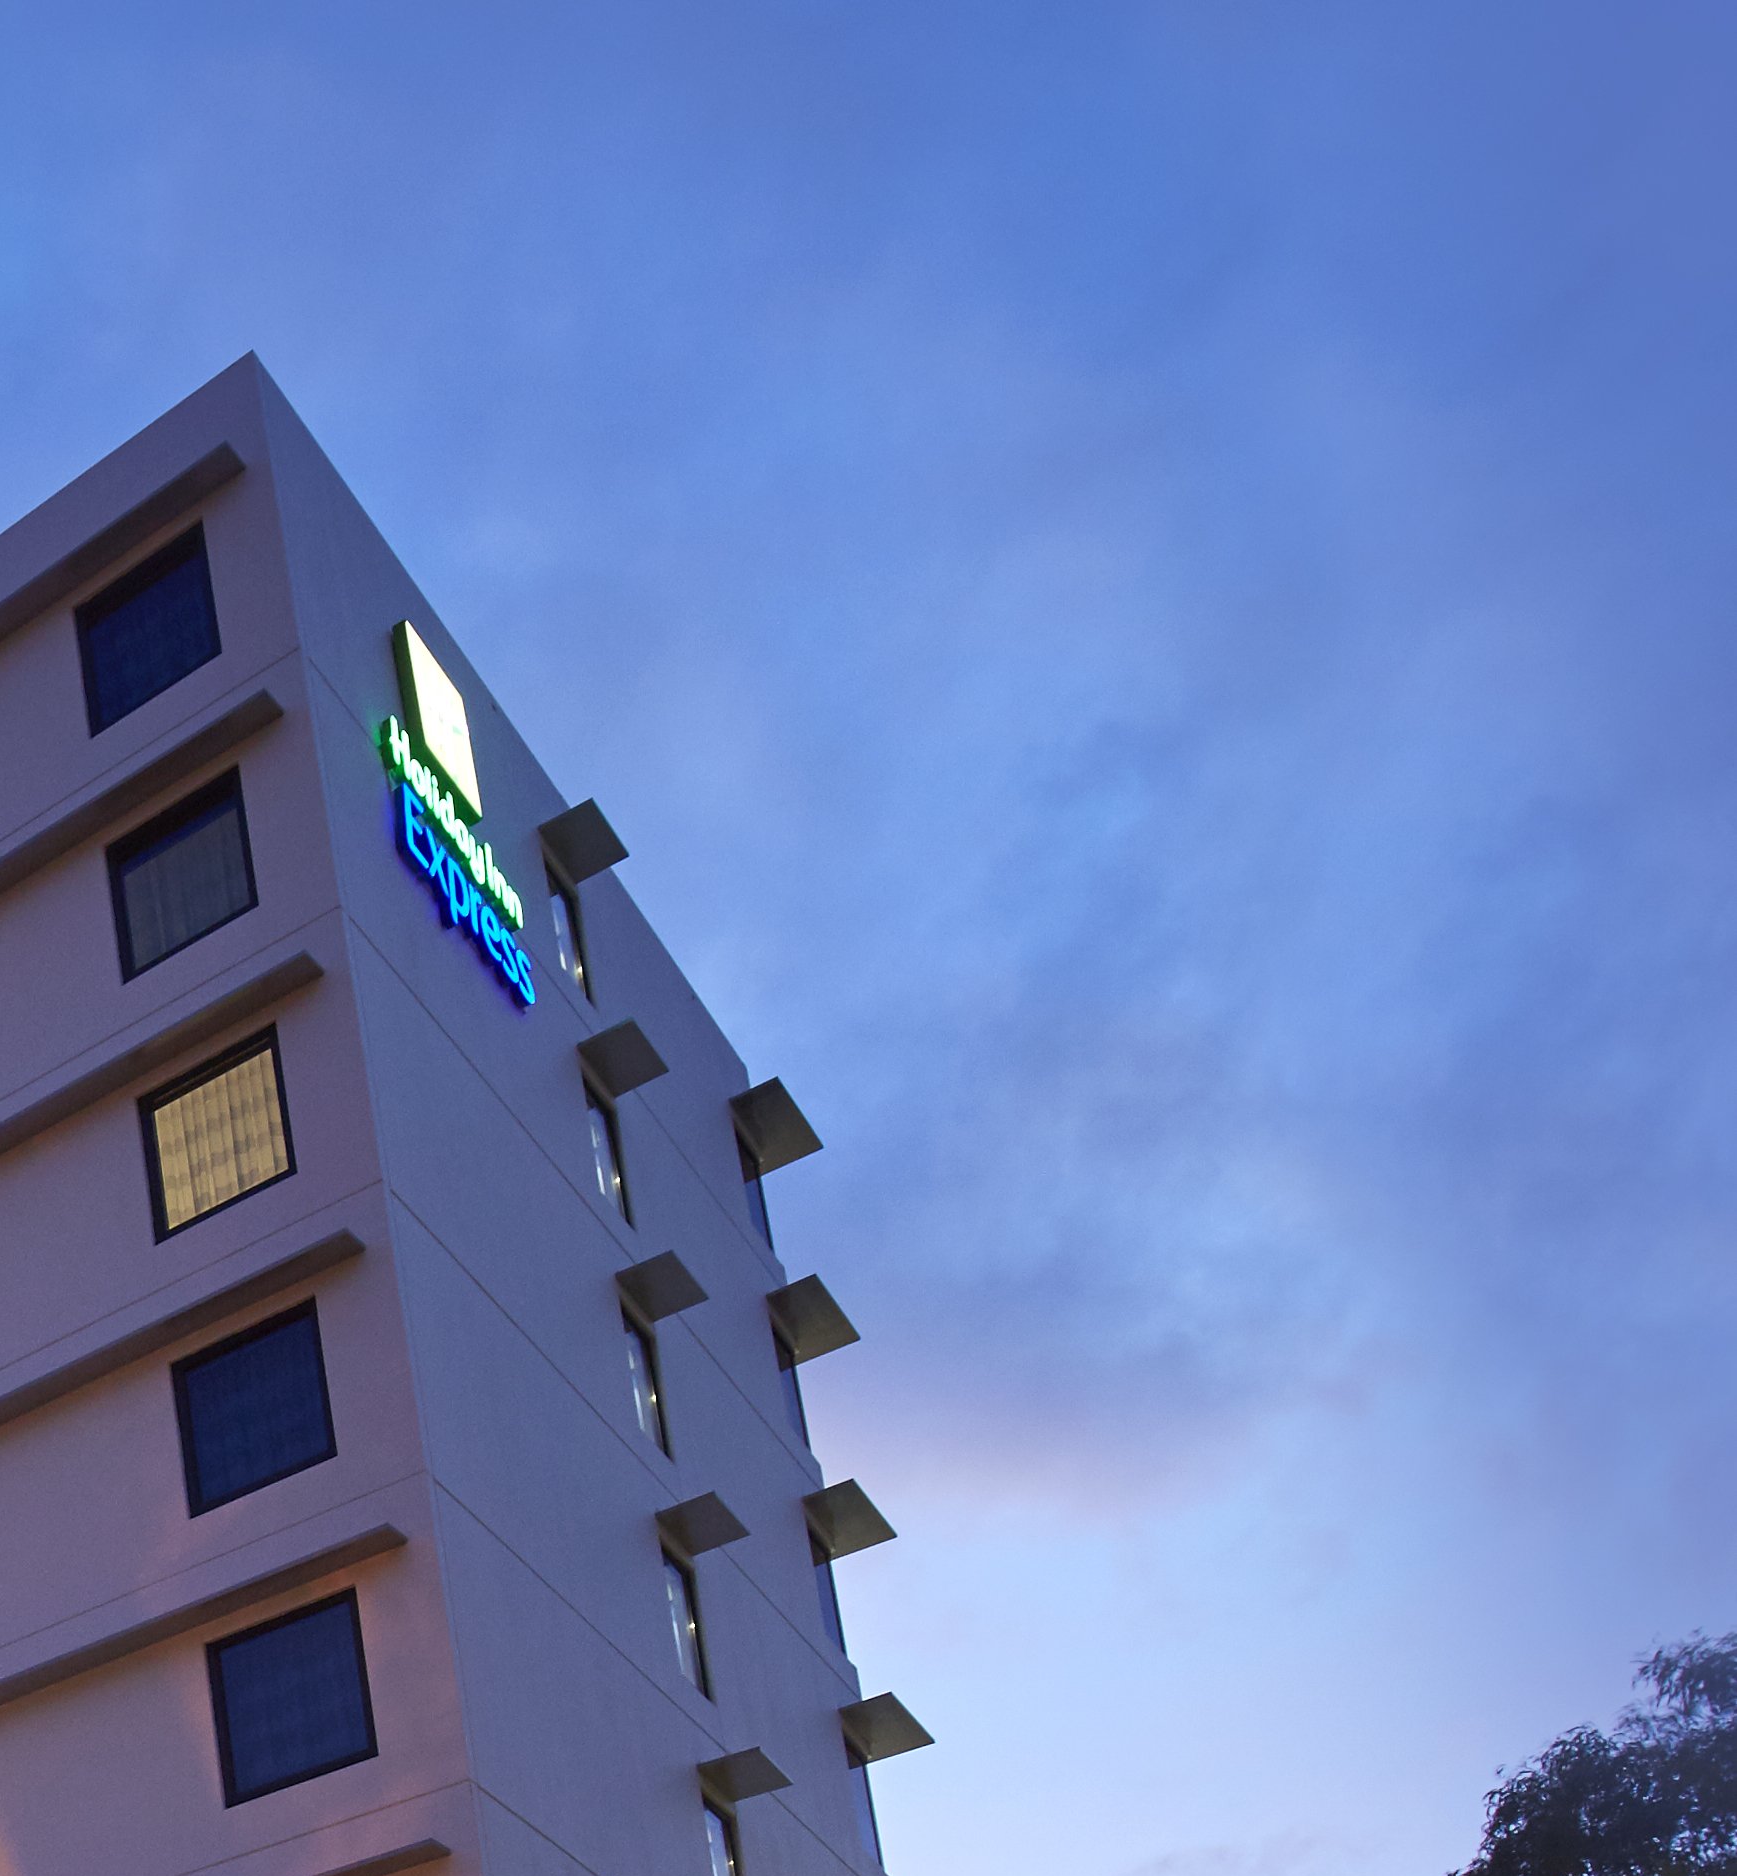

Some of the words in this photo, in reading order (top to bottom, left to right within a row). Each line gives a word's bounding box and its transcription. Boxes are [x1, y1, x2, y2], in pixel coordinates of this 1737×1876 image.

[387, 714, 486, 886] Holiday
[482, 842, 524, 929] Inn
[402, 782, 536, 1005] Express
